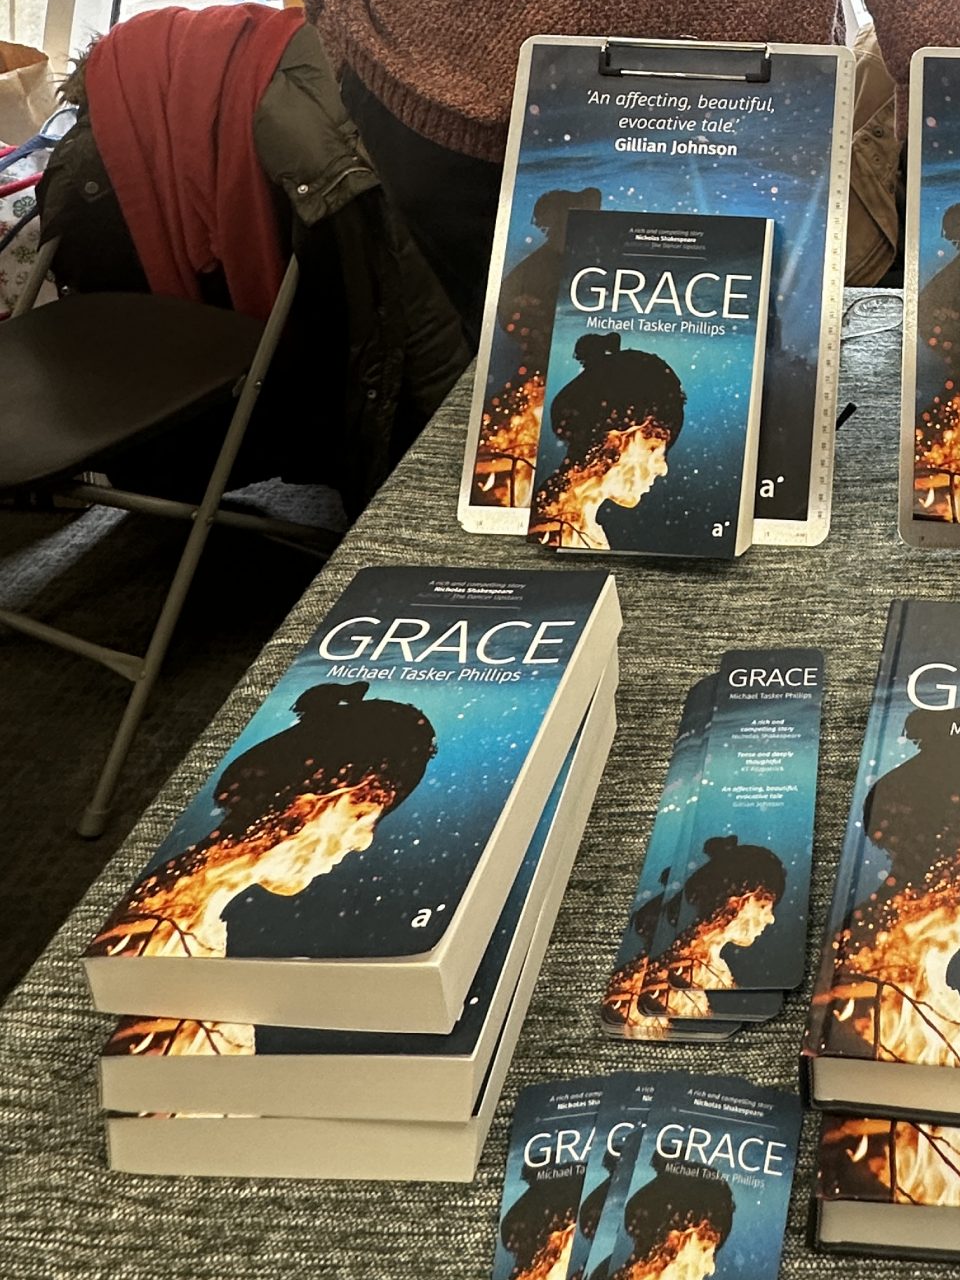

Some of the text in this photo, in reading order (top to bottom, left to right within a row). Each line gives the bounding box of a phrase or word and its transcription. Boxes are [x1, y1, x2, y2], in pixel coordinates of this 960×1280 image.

[616, 92, 692, 111] affecting,
[698, 95, 775, 114] beautiful,
[619, 116, 696, 132] evocative
[615, 138, 737, 156] Gillian Johnson
[570, 267, 752, 319] GRACE
[586, 317, 725, 337] Michael Tasker Phillips
[318, 616, 576, 664] GRACE
[326, 664, 522, 684] Michael Tasker Phillips
[728, 668, 818, 687] GRACE
[785, 692, 812, 700] Phillips
[694, 1098, 764, 1116] Nicholas Shakespeare
[656, 1124, 786, 1176] GRACE
[537, 1169, 572, 1180] Michael
[665, 1162, 700, 1177] Michael
[732, 1173, 765, 1188] Phillips
